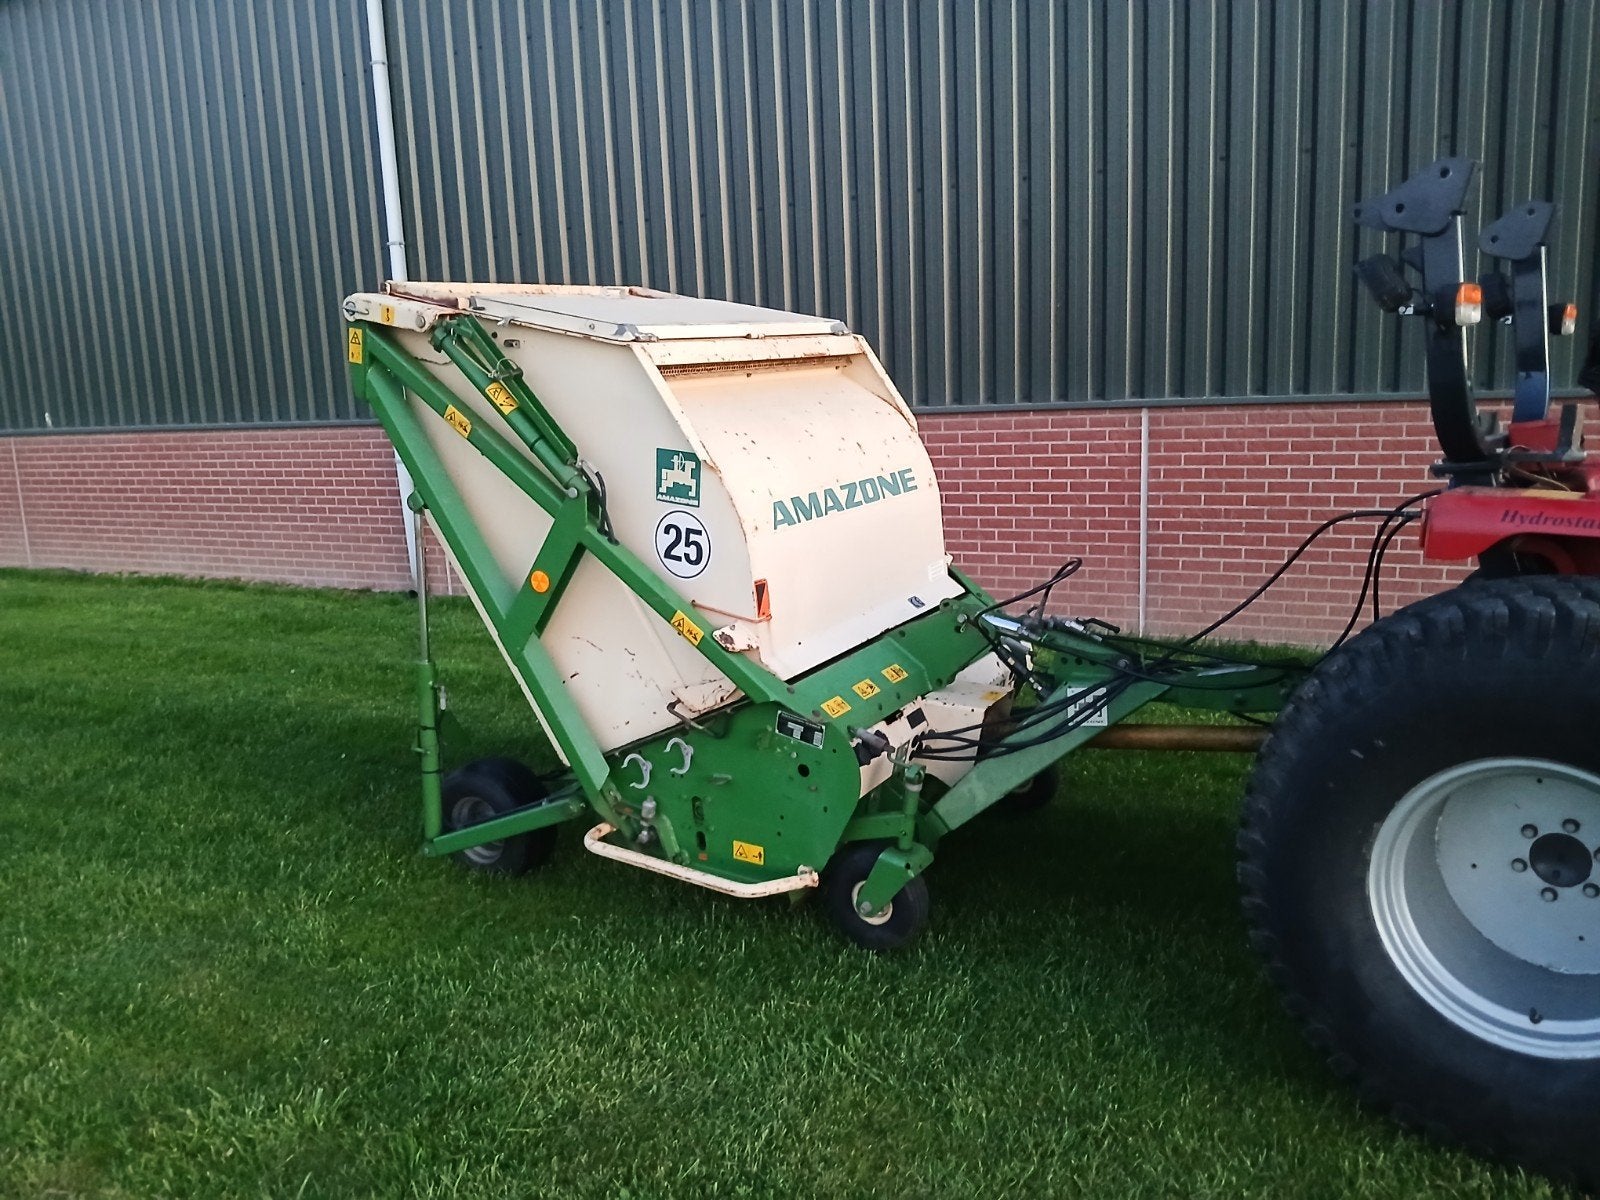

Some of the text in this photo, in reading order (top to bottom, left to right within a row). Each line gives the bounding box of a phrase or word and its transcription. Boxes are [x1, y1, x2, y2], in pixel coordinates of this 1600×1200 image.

[773, 468, 918, 530] AMAZONE
[1500, 509, 1600, 529] Hydrosta
[663, 523, 703, 566] 25
